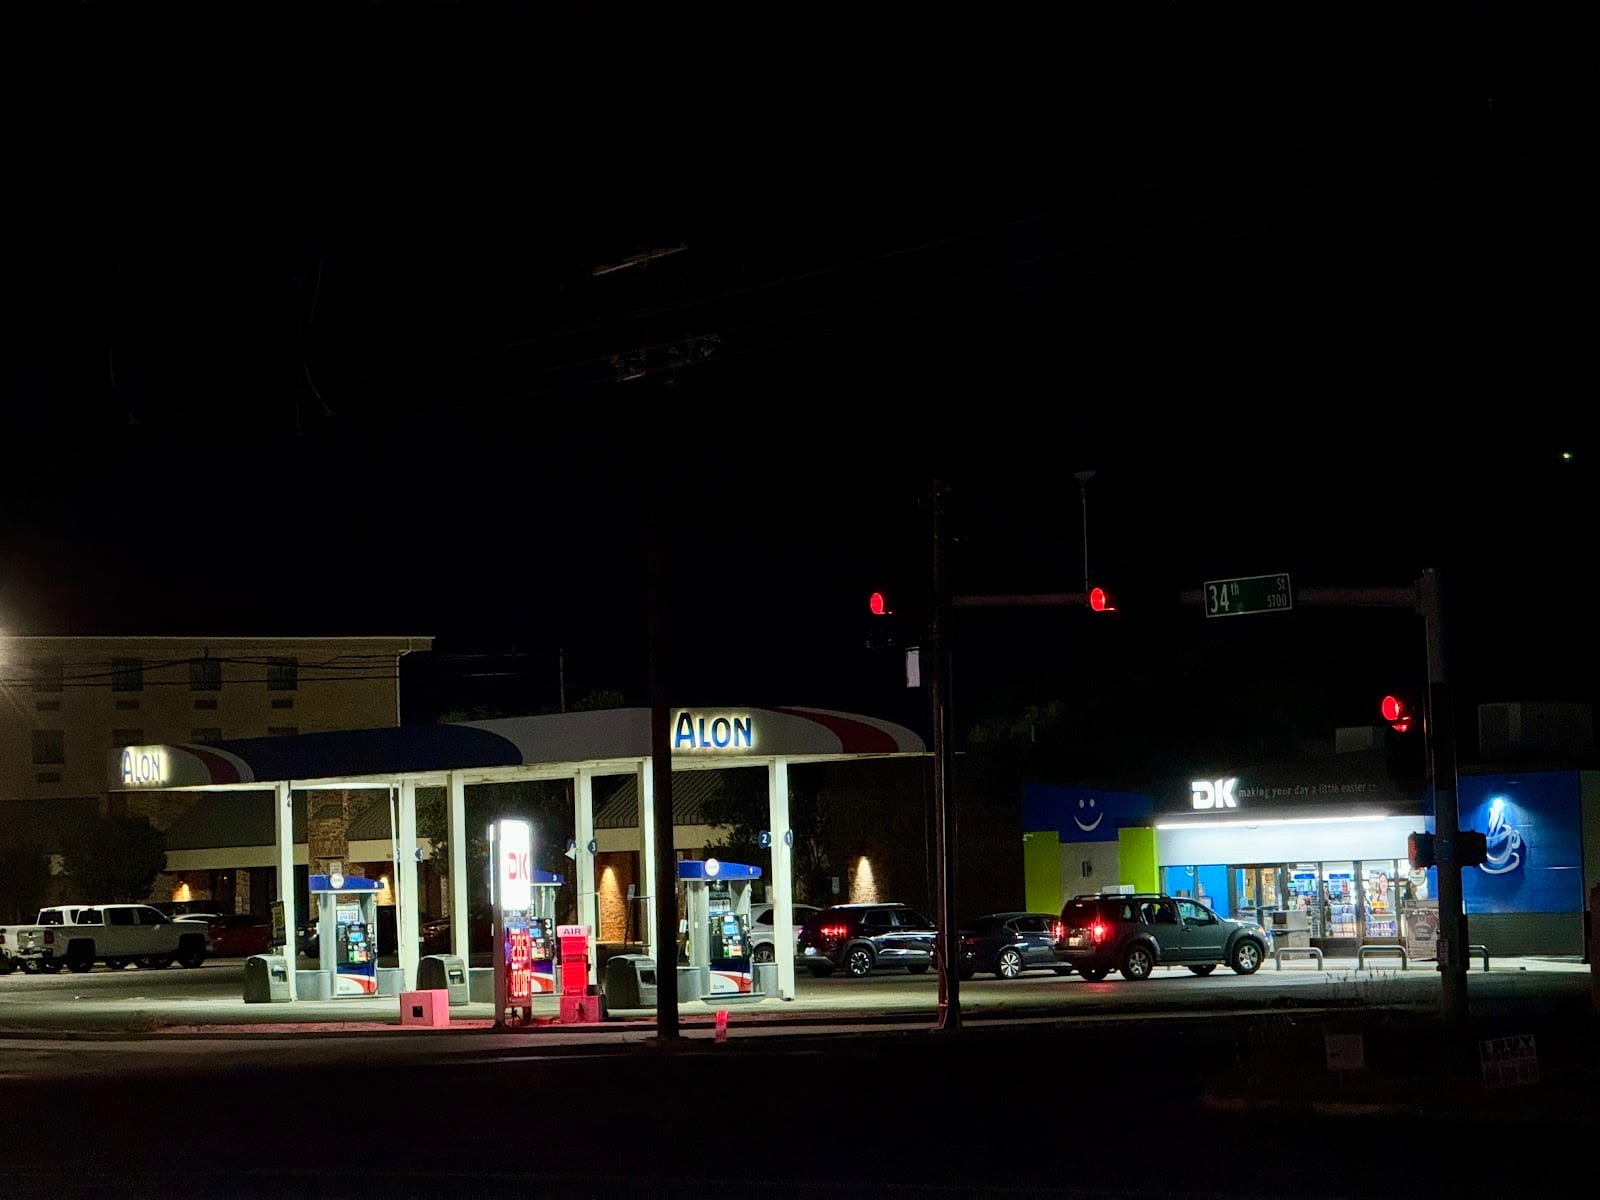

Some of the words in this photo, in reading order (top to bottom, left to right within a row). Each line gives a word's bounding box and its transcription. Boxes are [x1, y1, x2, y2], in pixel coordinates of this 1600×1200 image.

[1276, 577, 1286, 591] St
[674, 711, 752, 748] ALON
[121, 750, 161, 782] ALON
[1191, 778, 1237, 810] DK
[1239, 786, 1270, 800] making
[1271, 786, 1291, 798] your
[1294, 784, 1309, 797] day
[1319, 783, 1340, 794] little
[1341, 783, 1366, 794] easier
[762, 833, 769, 844] 2
[591, 842, 597, 852] 3
[508, 852, 529, 880] DK
[545, 919, 551, 929] 3
[563, 927, 582, 935] AIR
